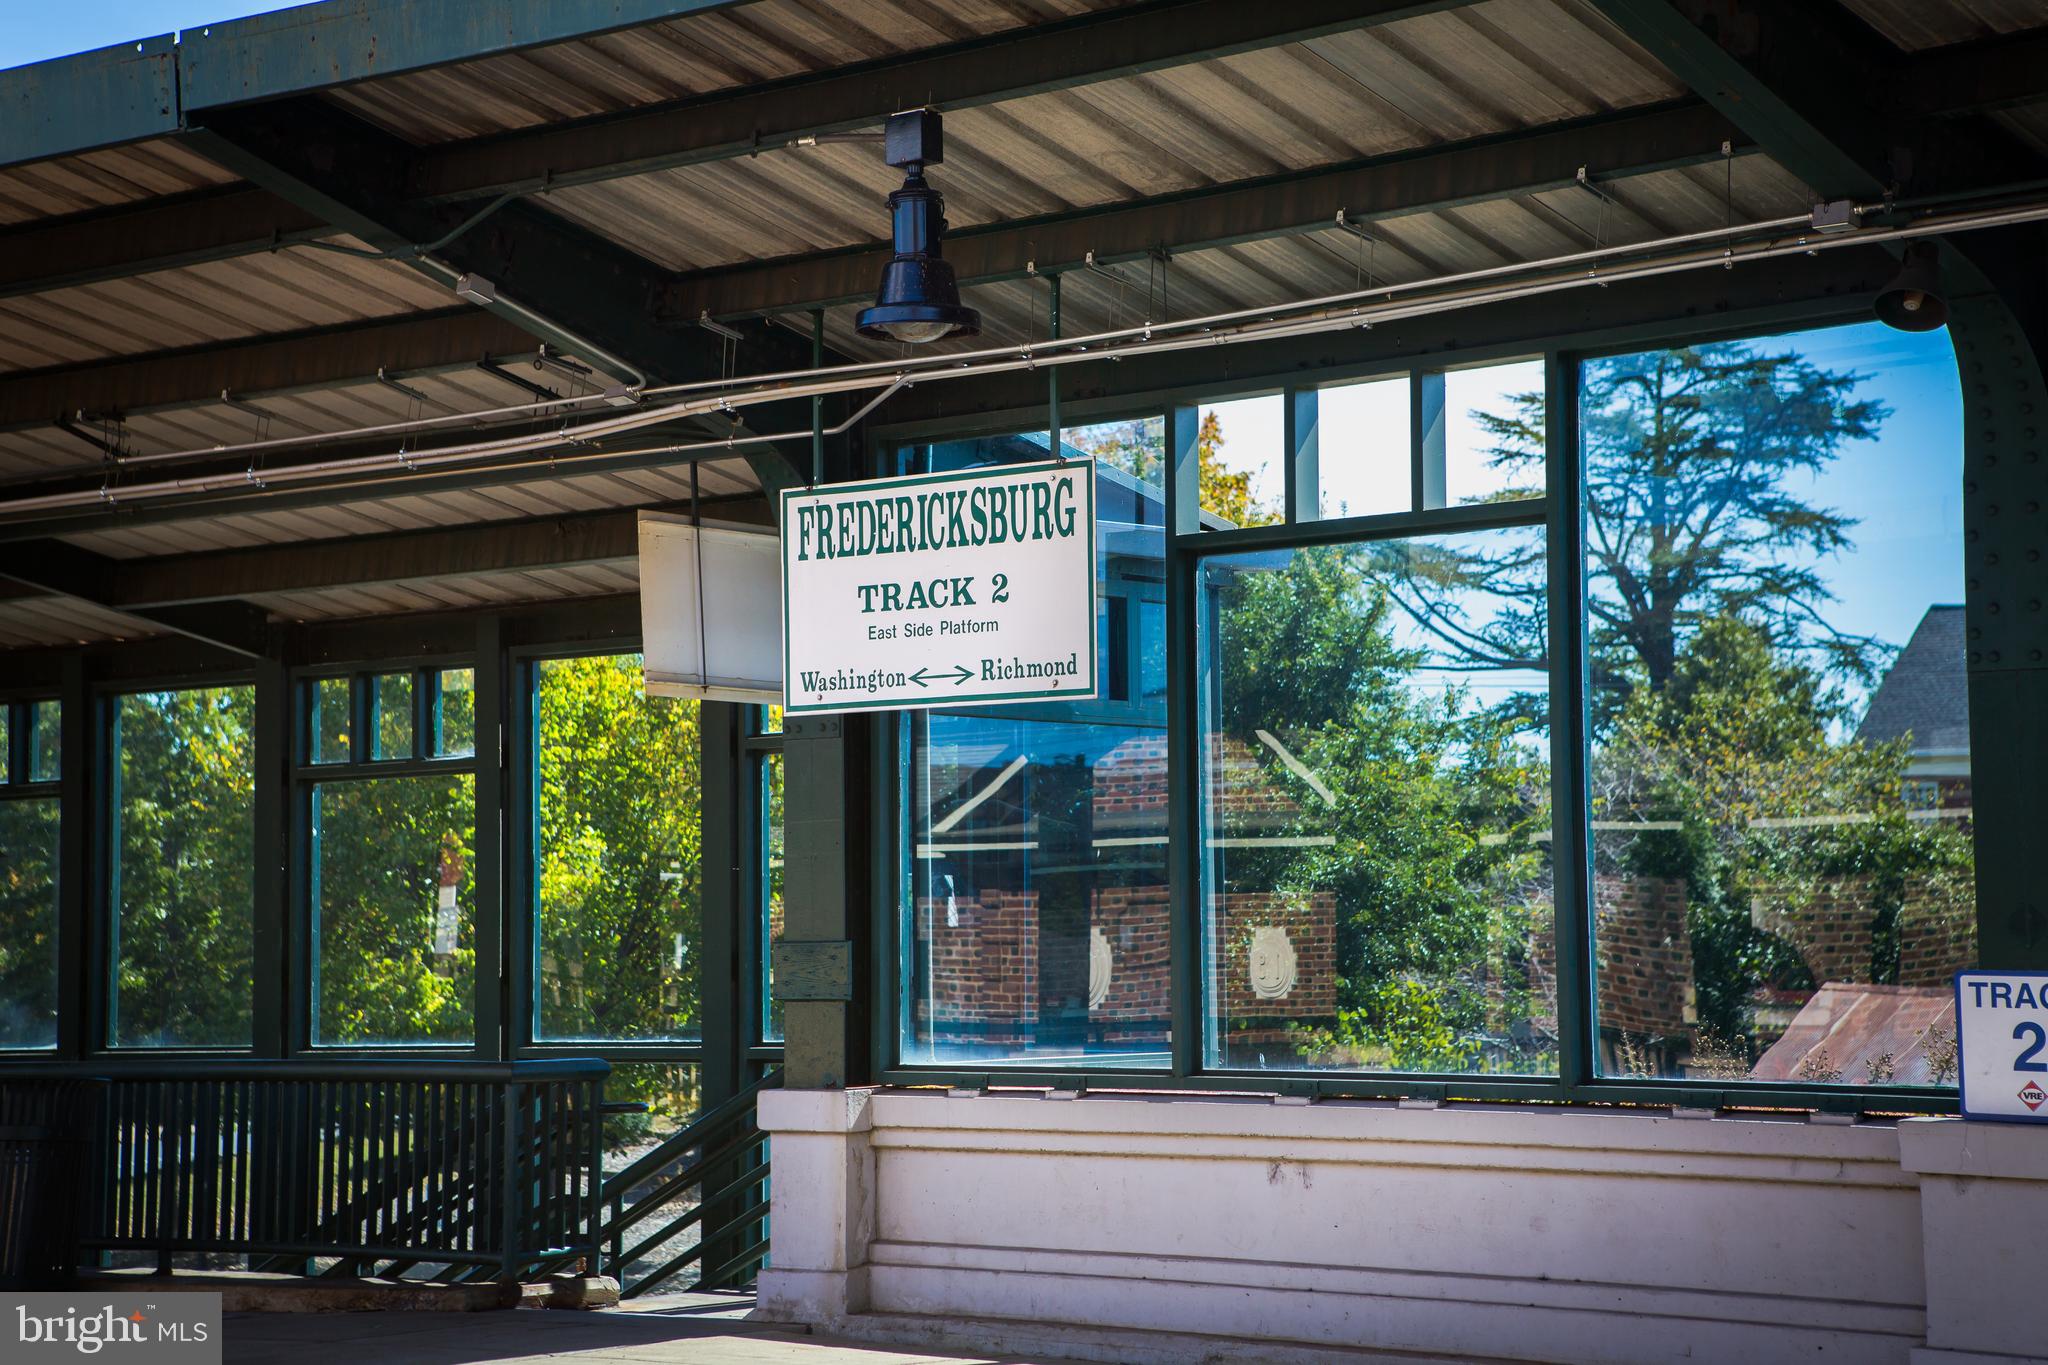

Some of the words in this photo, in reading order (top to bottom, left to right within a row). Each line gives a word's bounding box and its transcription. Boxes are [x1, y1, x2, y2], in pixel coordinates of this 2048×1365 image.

[797, 477, 1077, 561] FREDERICKSBURG
[857, 576, 977, 613] TRACK
[991, 573, 1010, 604] 2
[868, 624, 898, 640] East
[904, 622, 933, 638] Side
[940, 619, 999, 635] Platform
[800, 669, 907, 693] Washington
[981, 653, 1078, 681] Richmond
[2012, 1021, 2048, 1072] 2
[2023, 1091, 2044, 1101] VRE
